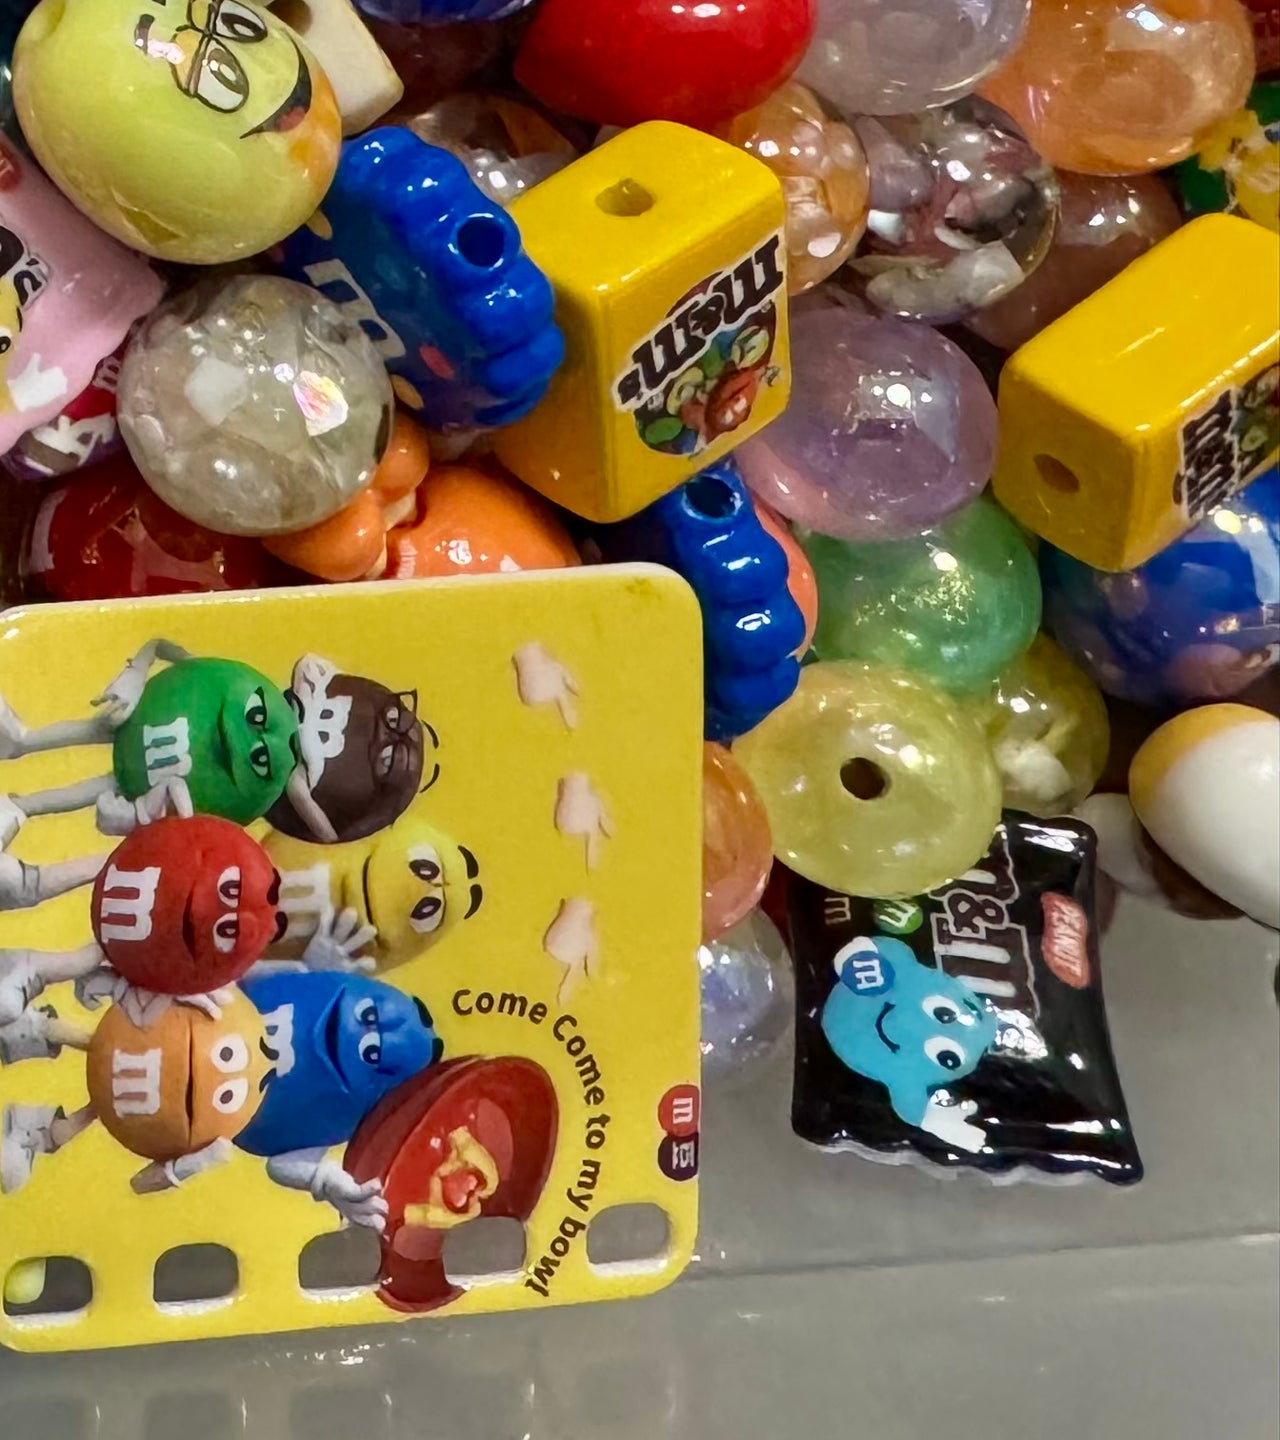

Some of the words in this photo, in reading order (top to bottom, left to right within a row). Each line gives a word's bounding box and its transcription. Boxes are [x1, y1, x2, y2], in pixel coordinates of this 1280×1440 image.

[143, 717, 193, 786] m
[101, 862, 161, 943] m
[879, 903, 917, 930] m
[853, 959, 883, 989] m
[452, 988, 548, 1024] Come
[553, 1015, 605, 1106] Come
[111, 1048, 162, 1118] m
[585, 1113, 611, 1149] to
[672, 1098, 693, 1123] m
[567, 1160, 601, 1211] my
